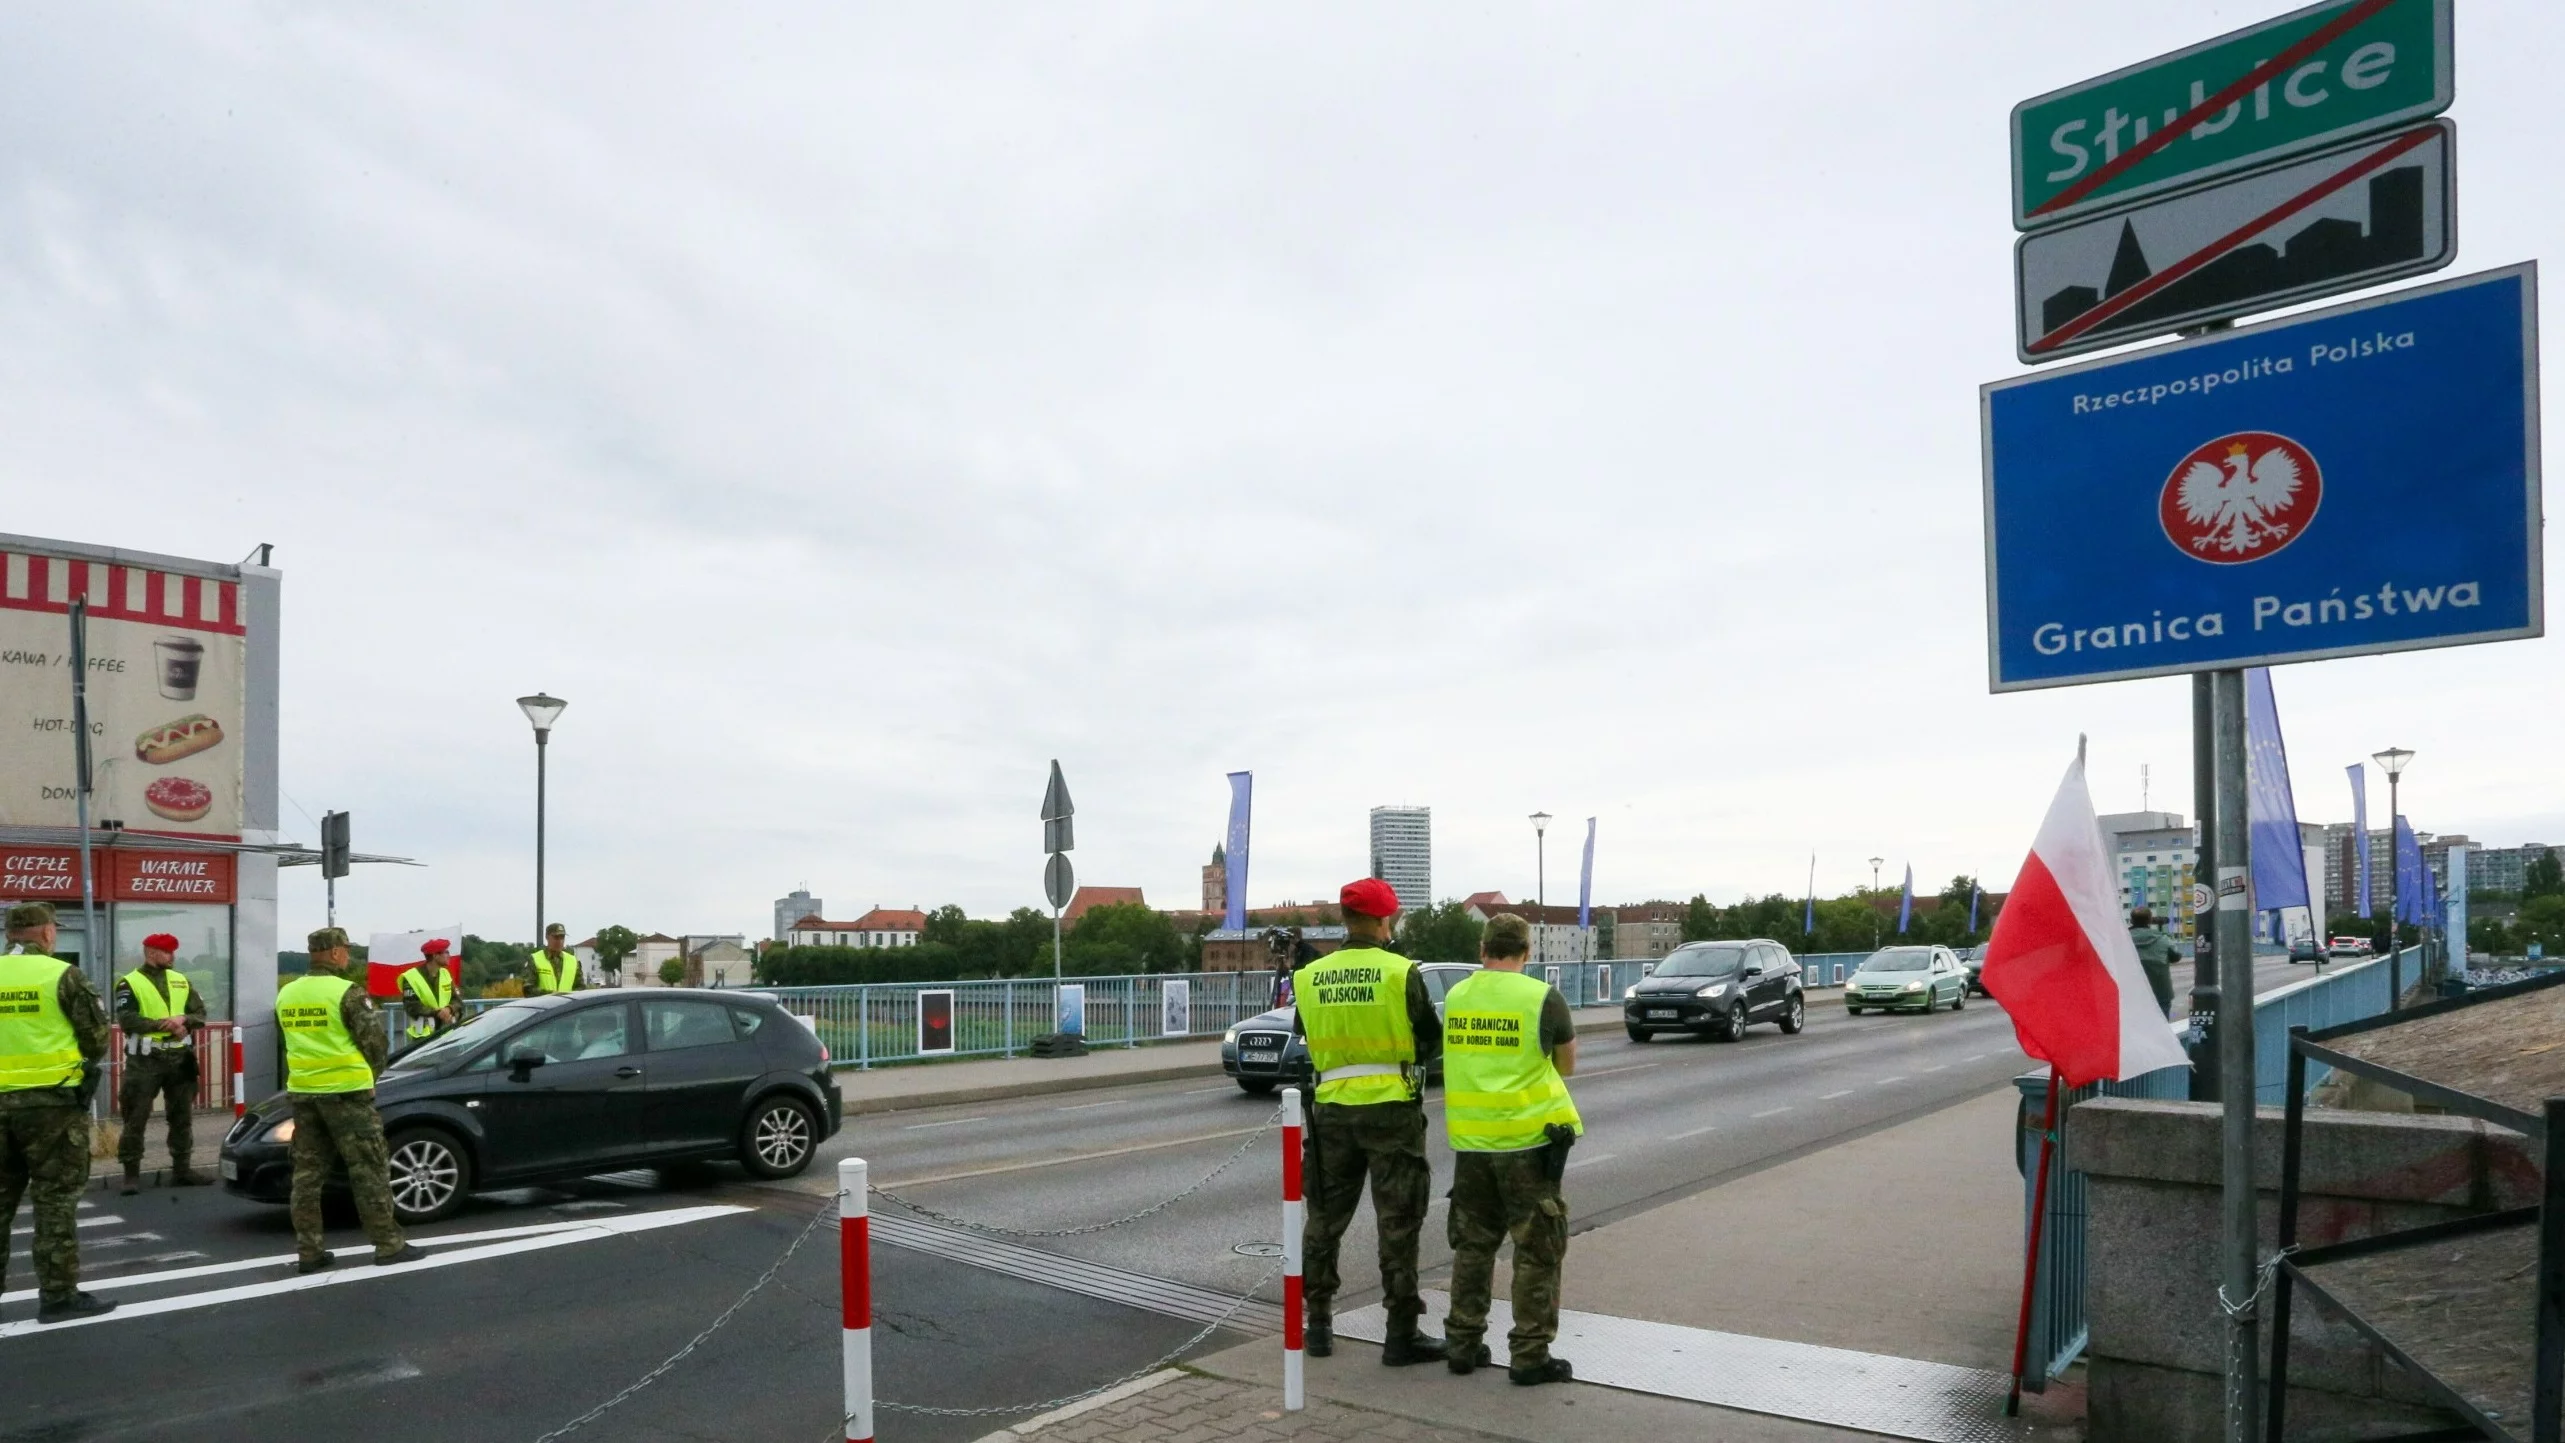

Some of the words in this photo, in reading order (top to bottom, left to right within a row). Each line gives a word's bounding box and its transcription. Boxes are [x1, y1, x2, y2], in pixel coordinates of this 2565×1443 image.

[2046, 41, 2396, 183] Słubice
[2073, 356, 2294, 415] Rzeczpospolita
[2310, 331, 2415, 367] Polska
[2033, 610, 2224, 656] Granica
[2253, 581, 2481, 631] Państwa
[2, 650, 47, 666] KAWA
[68, 656, 126, 673] FFEE
[34, 718, 104, 736] HOT-DG
[41, 785, 95, 801] DONT
[5, 855, 71, 872] CIEPŁE
[141, 859, 208, 877] WARME
[3, 874, 73, 893] PĄCZKI
[131, 877, 216, 894] BERLINER
[1318, 985, 1375, 1005] WOJSKOWA
[1471, 1017, 1520, 1032] GRANICZNA
[1466, 1034, 1493, 1046] BORDER
[1495, 1036, 1520, 1048] GUARD
